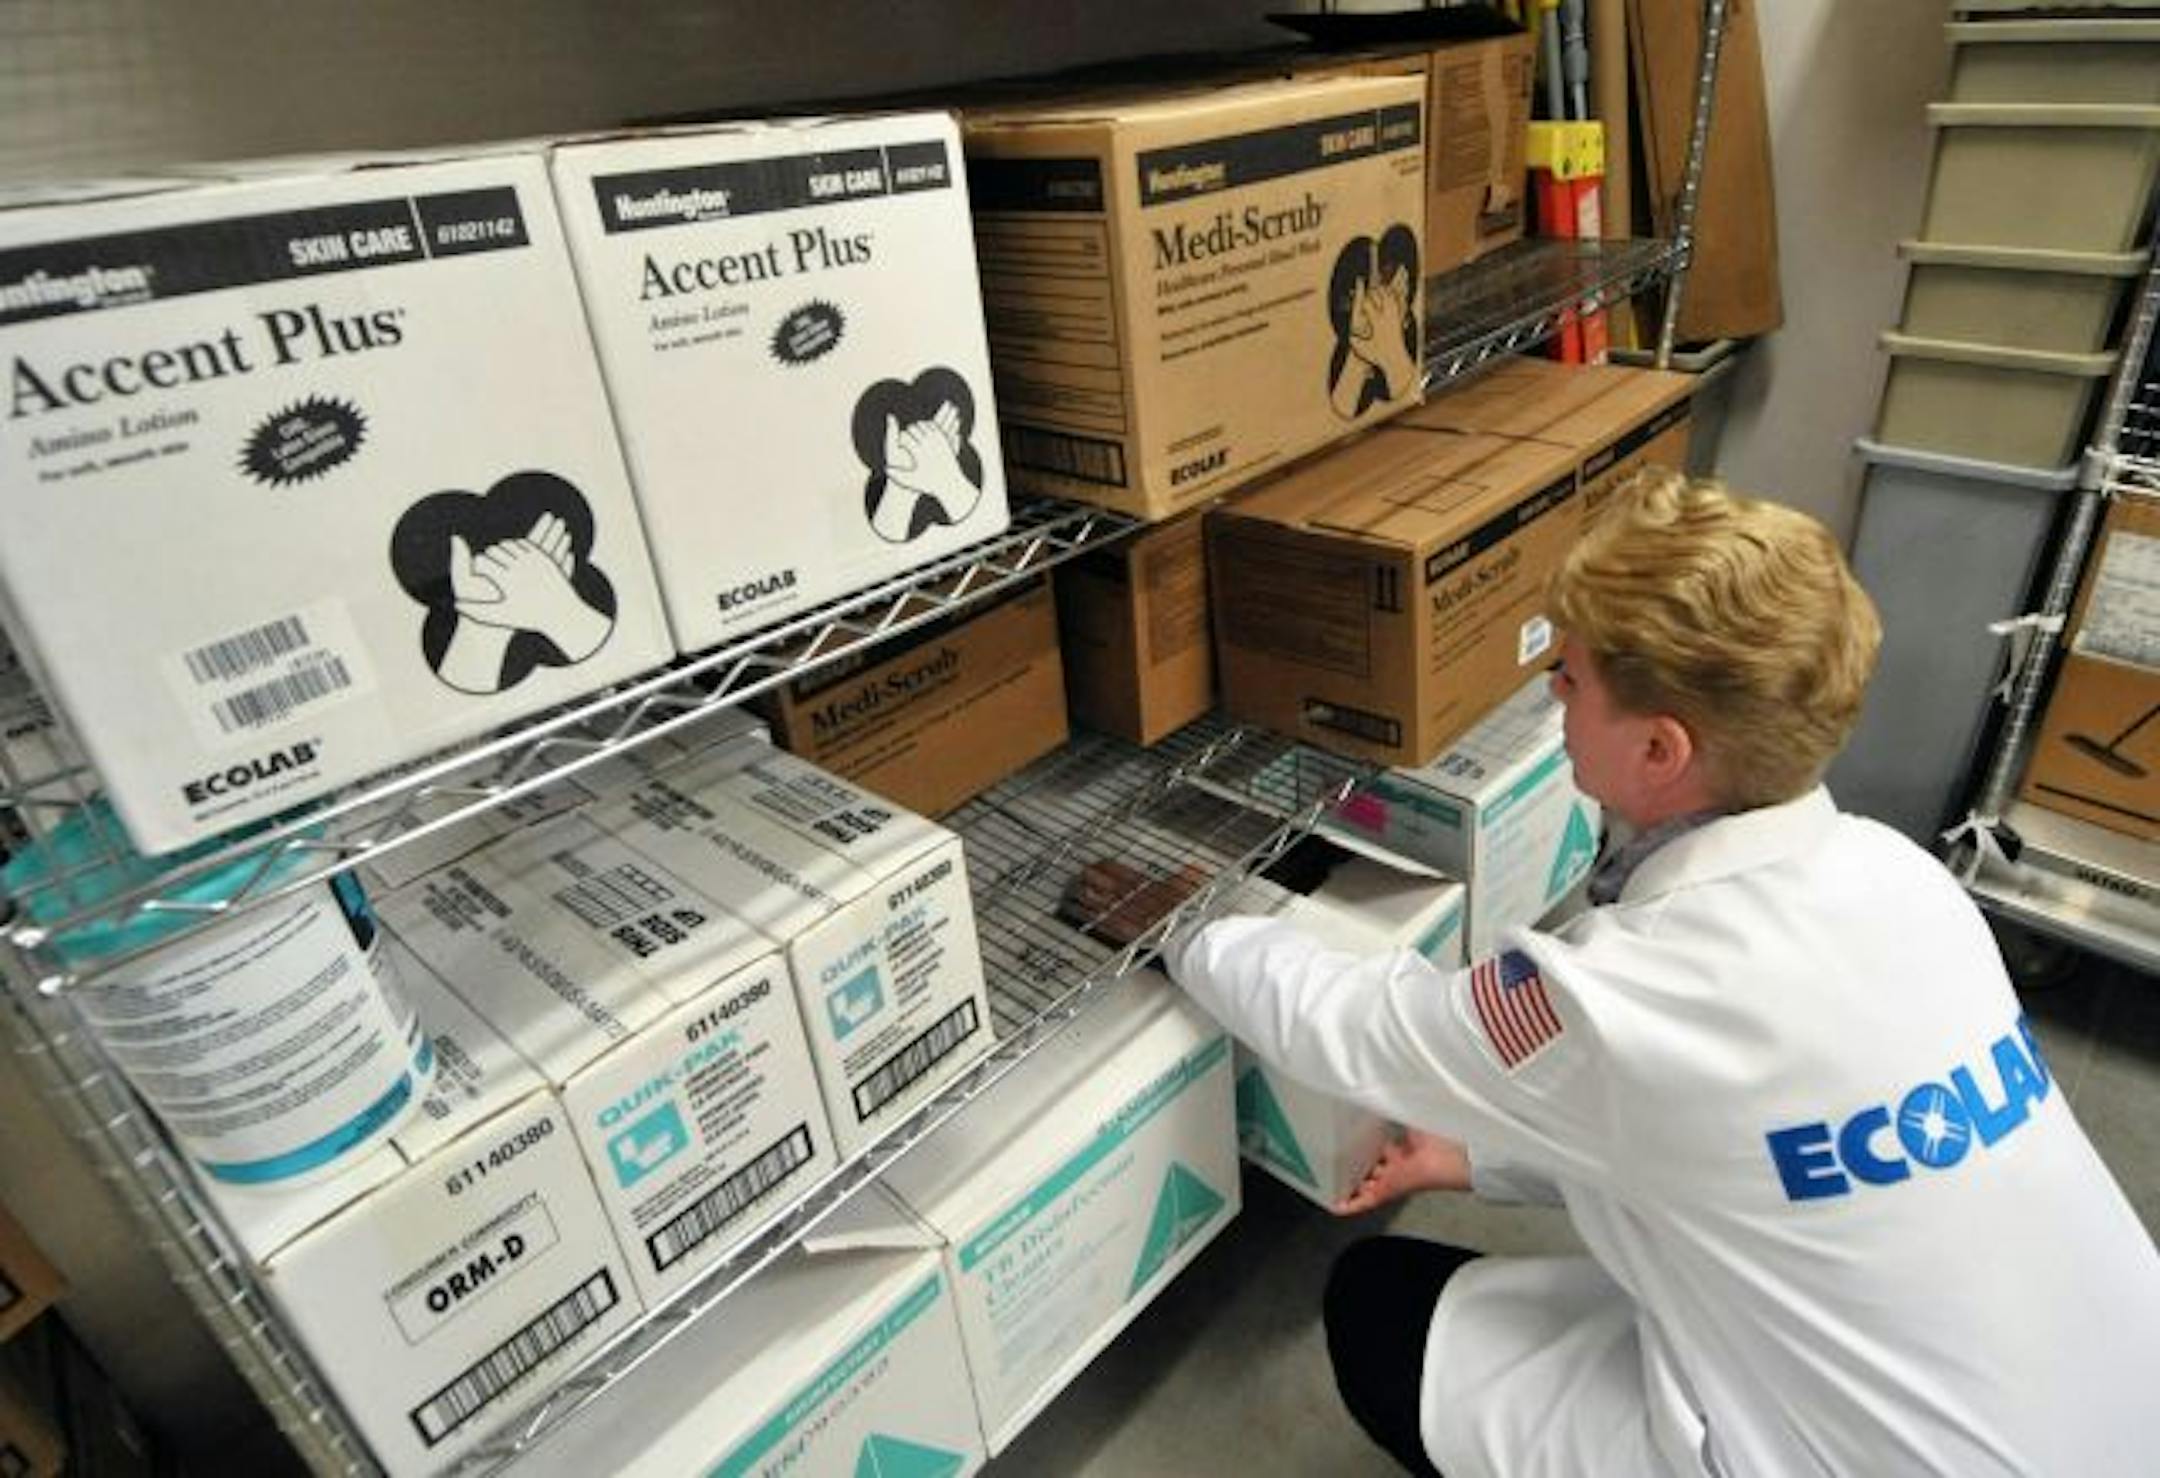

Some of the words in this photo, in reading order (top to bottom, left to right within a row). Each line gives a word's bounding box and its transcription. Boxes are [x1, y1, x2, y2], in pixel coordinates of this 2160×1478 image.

[614, 187, 727, 222] Huntington
[808, 172, 846, 198] SKIN
[846, 168, 882, 193] CARE
[1152, 193, 1321, 270] Medi-Scrub
[289, 235, 348, 267] SKIN
[350, 225, 413, 258] CARE
[641, 244, 781, 301] Accent
[787, 226, 872, 274] Plus
[8, 327, 254, 418] Accent
[257, 291, 403, 365] Plus
[30, 427, 112, 458] Amino
[119, 408, 199, 439] Lotion
[718, 569, 797, 611] ECOLAB
[810, 648, 958, 731] Medi-Scrub
[182, 741, 317, 806] ECOLAB
[598, 1028, 740, 1128] QUIK-PAK
[445, 1117, 554, 1196] 61140380
[426, 1233, 525, 1312] ORM-D
